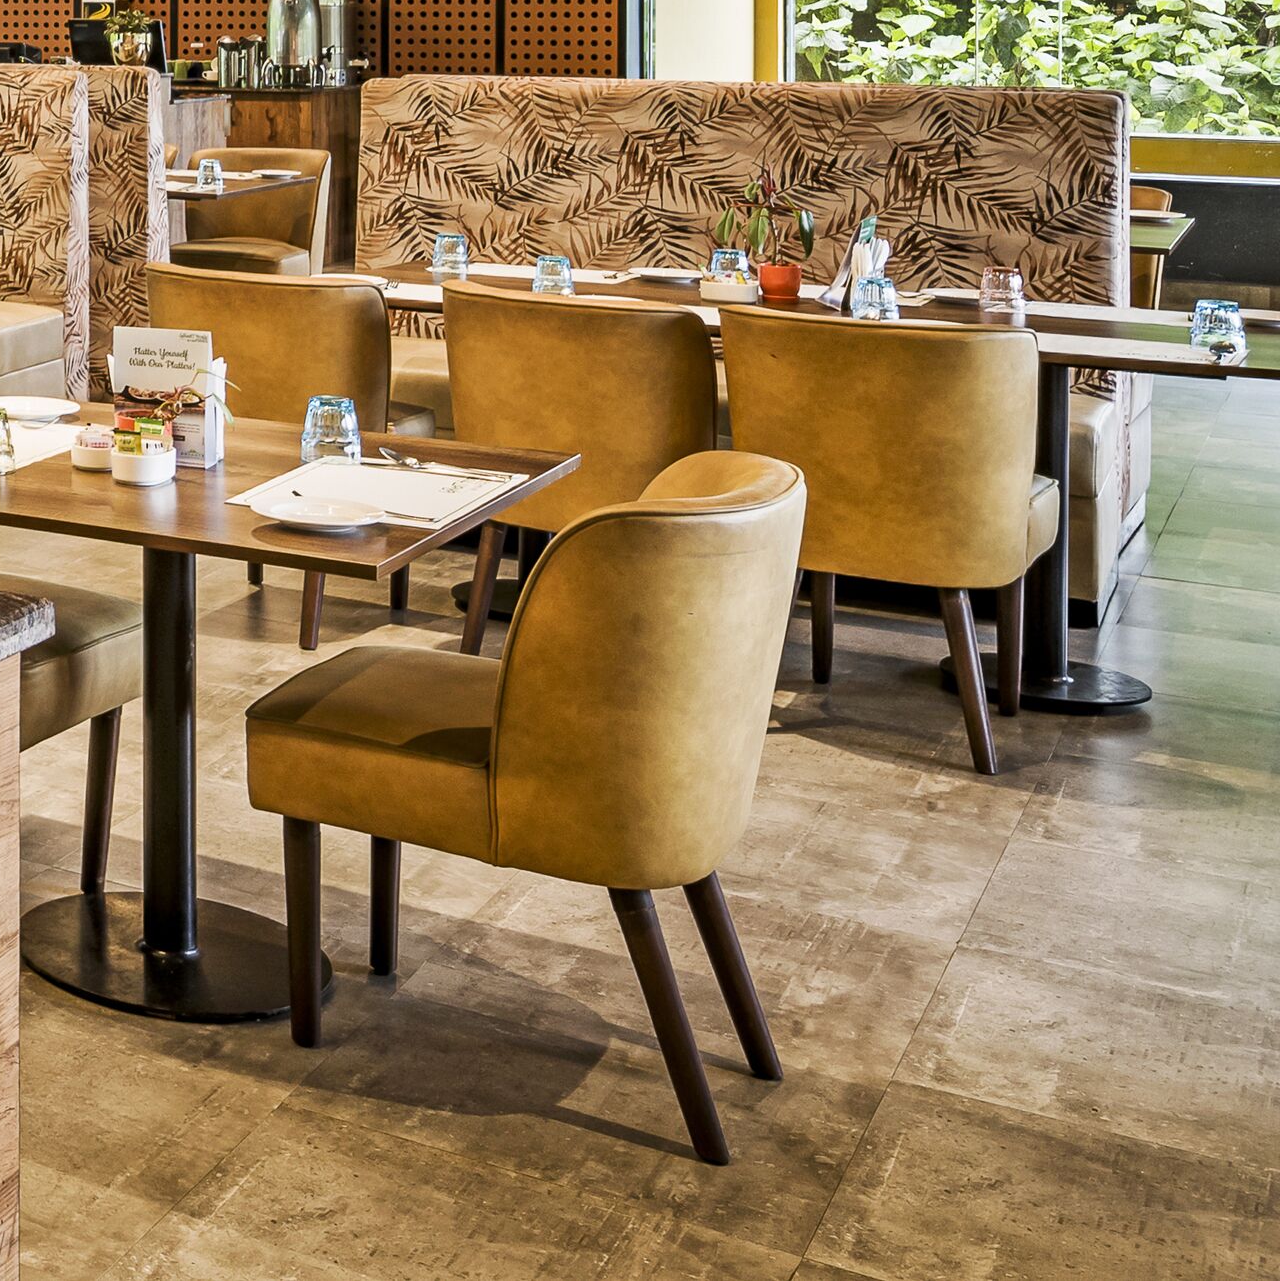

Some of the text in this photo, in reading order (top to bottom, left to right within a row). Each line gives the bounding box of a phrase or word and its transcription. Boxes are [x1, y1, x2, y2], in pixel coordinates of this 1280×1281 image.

[133, 347, 188, 361] Flatter Yourself
[129, 358, 195, 370] With Our Platters!
